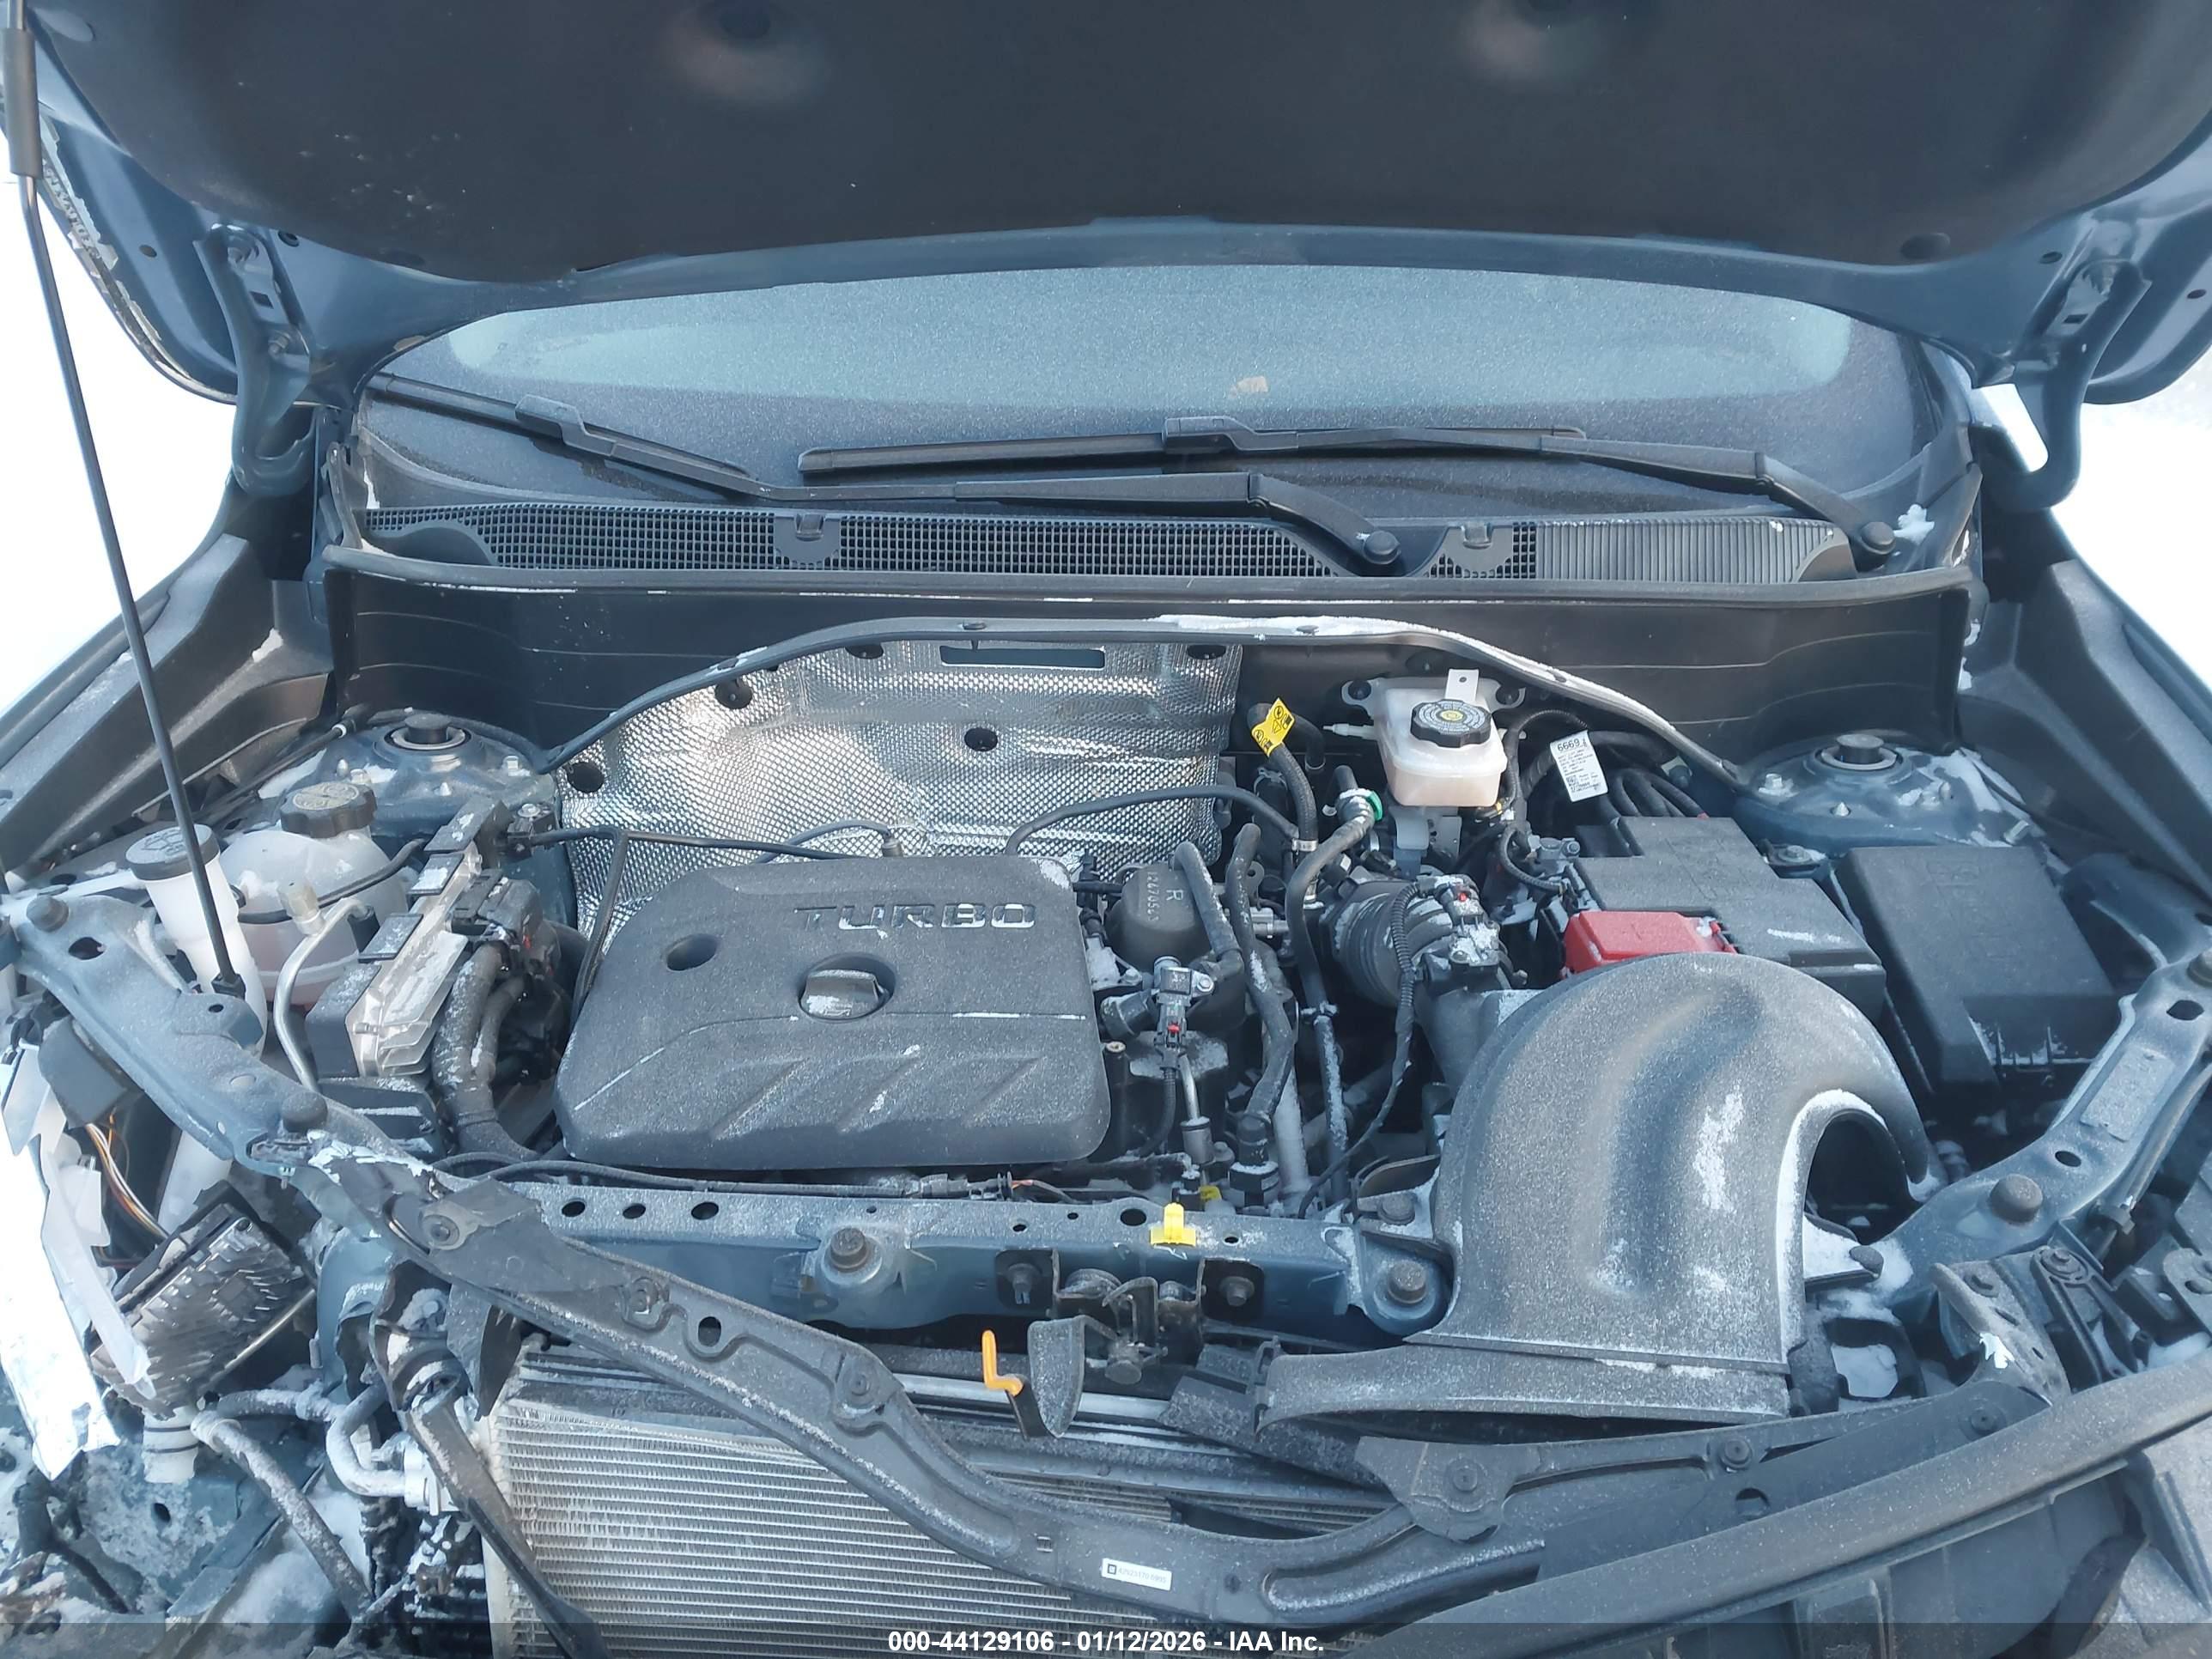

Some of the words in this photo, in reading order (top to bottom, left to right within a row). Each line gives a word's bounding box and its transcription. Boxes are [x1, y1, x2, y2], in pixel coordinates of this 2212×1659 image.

[1557, 738, 1581, 751] 6669
[1165, 889, 1184, 902] R
[793, 902, 1036, 931] TURBO
